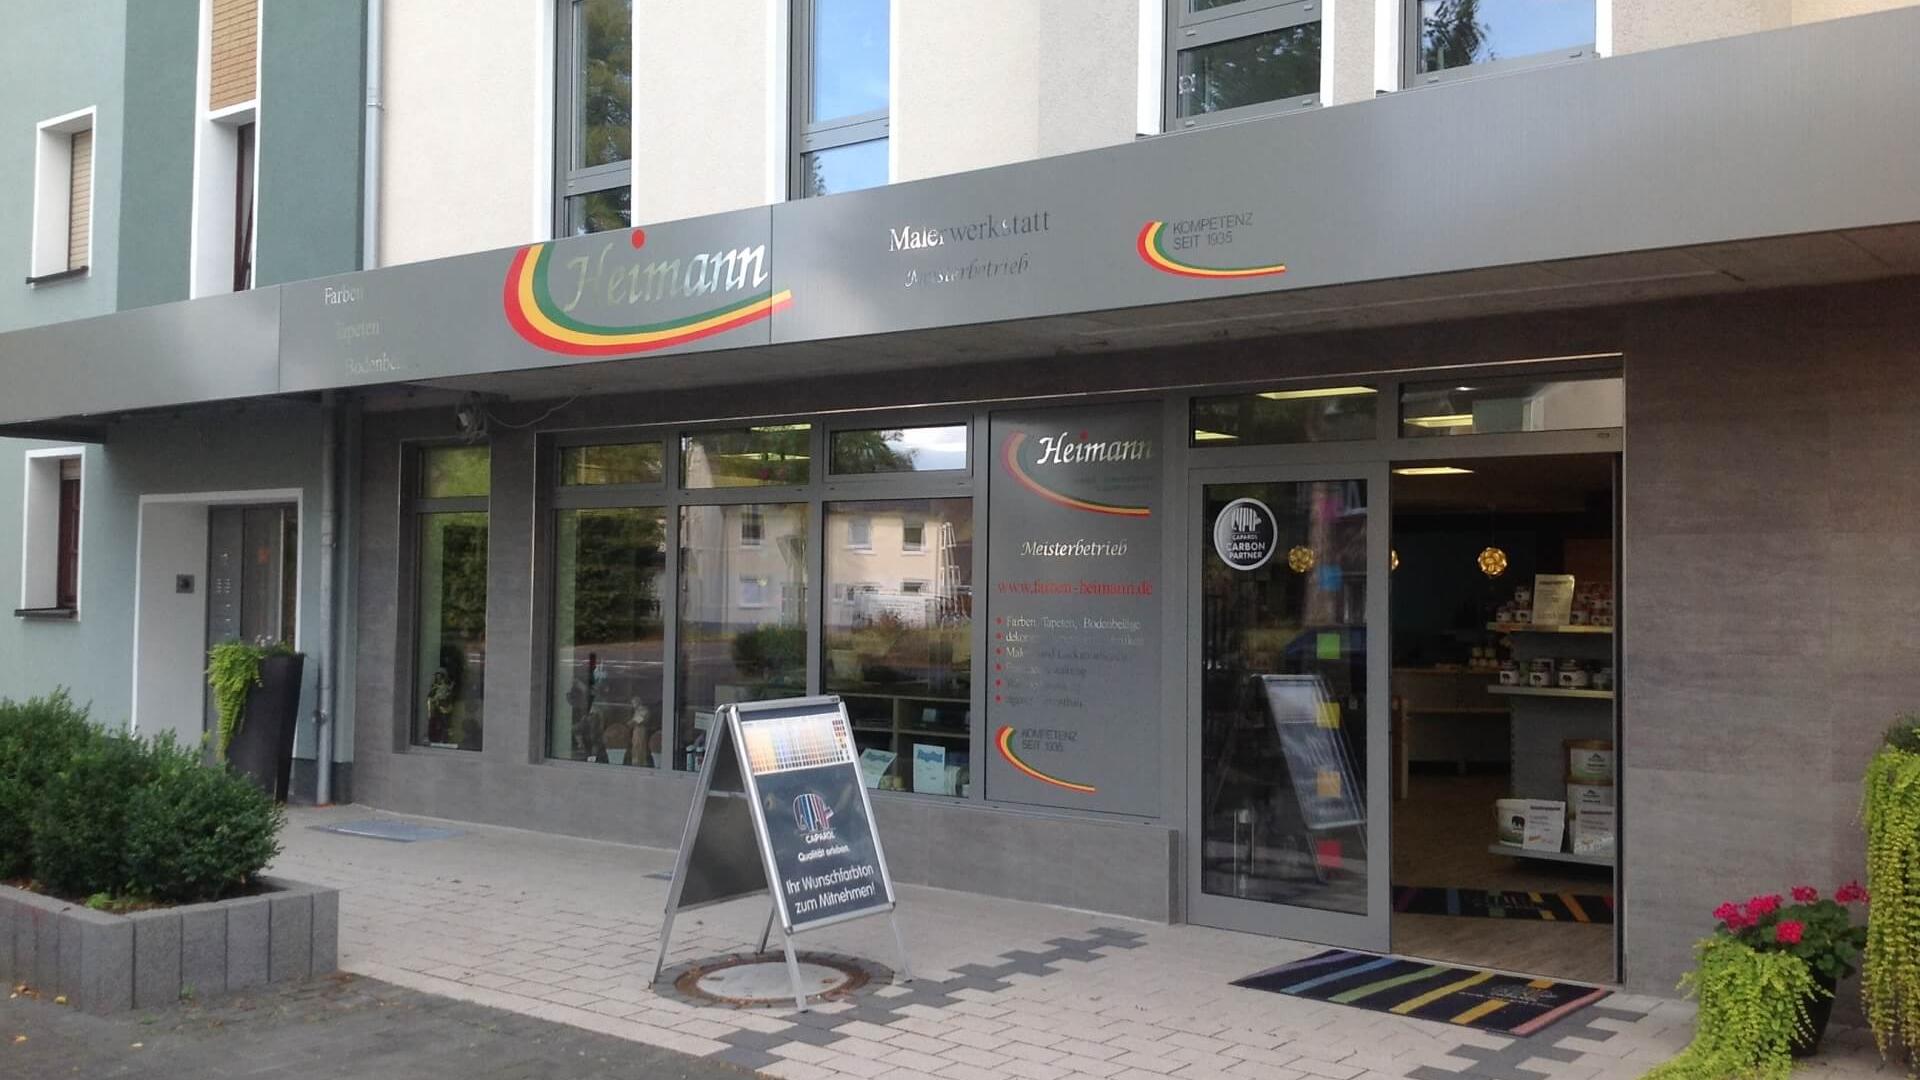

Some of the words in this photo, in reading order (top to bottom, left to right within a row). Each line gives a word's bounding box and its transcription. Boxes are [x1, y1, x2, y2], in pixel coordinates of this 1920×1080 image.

[888, 210, 1050, 252] Malerwerkstatt
[1173, 211, 1254, 236] KOMPETENZ
[1173, 234, 1201, 251] SEIT
[563, 229, 769, 313] Heimann
[1036, 429, 1152, 465] Heimann
[1020, 539, 1128, 556] Meisterbetrieb
[1226, 541, 1266, 551] CARBON
[1229, 551, 1263, 560] PARTNER
[786, 879, 801, 895] Ihr
[801, 864, 875, 891] Wunschfarbton
[795, 898, 818, 914] zum
[818, 881, 876, 909] Mitnehmen!
